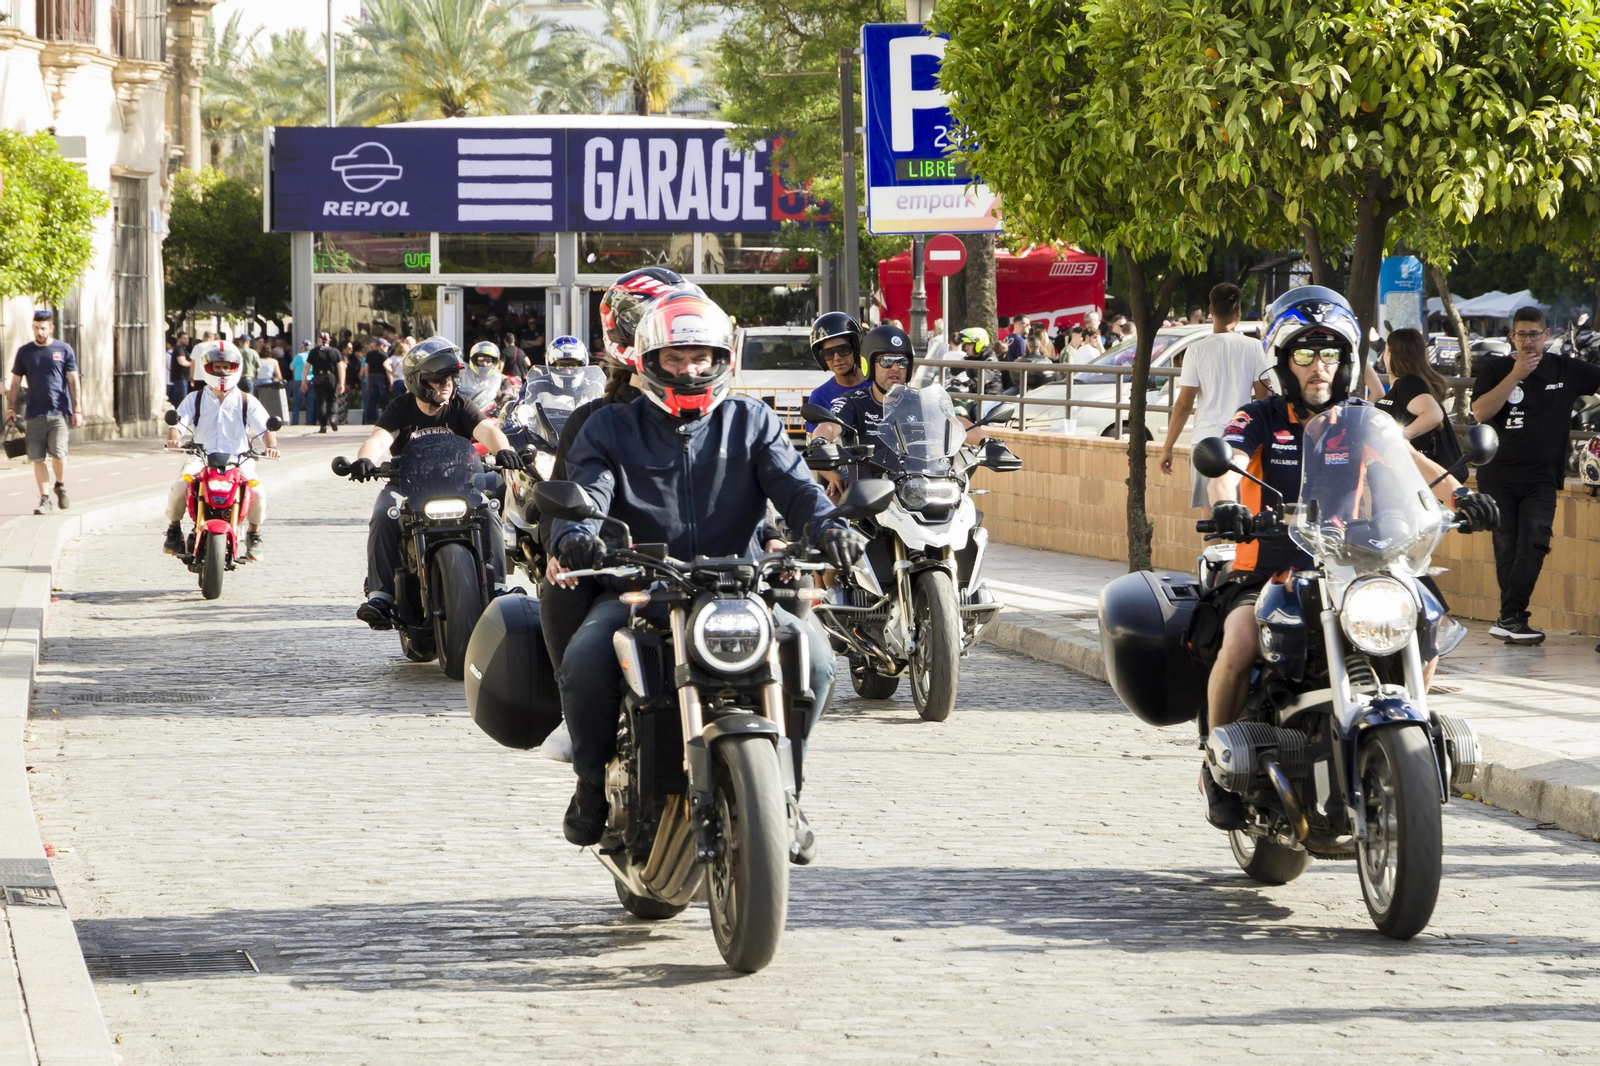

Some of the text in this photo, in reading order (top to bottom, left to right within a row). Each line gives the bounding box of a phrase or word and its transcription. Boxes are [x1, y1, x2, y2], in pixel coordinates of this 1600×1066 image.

[889, 36, 955, 152] P
[584, 137, 767, 222] GARAGE
[908, 160, 957, 178] LIBRE
[322, 200, 410, 217] REPSOL
[896, 192, 976, 214] empark
